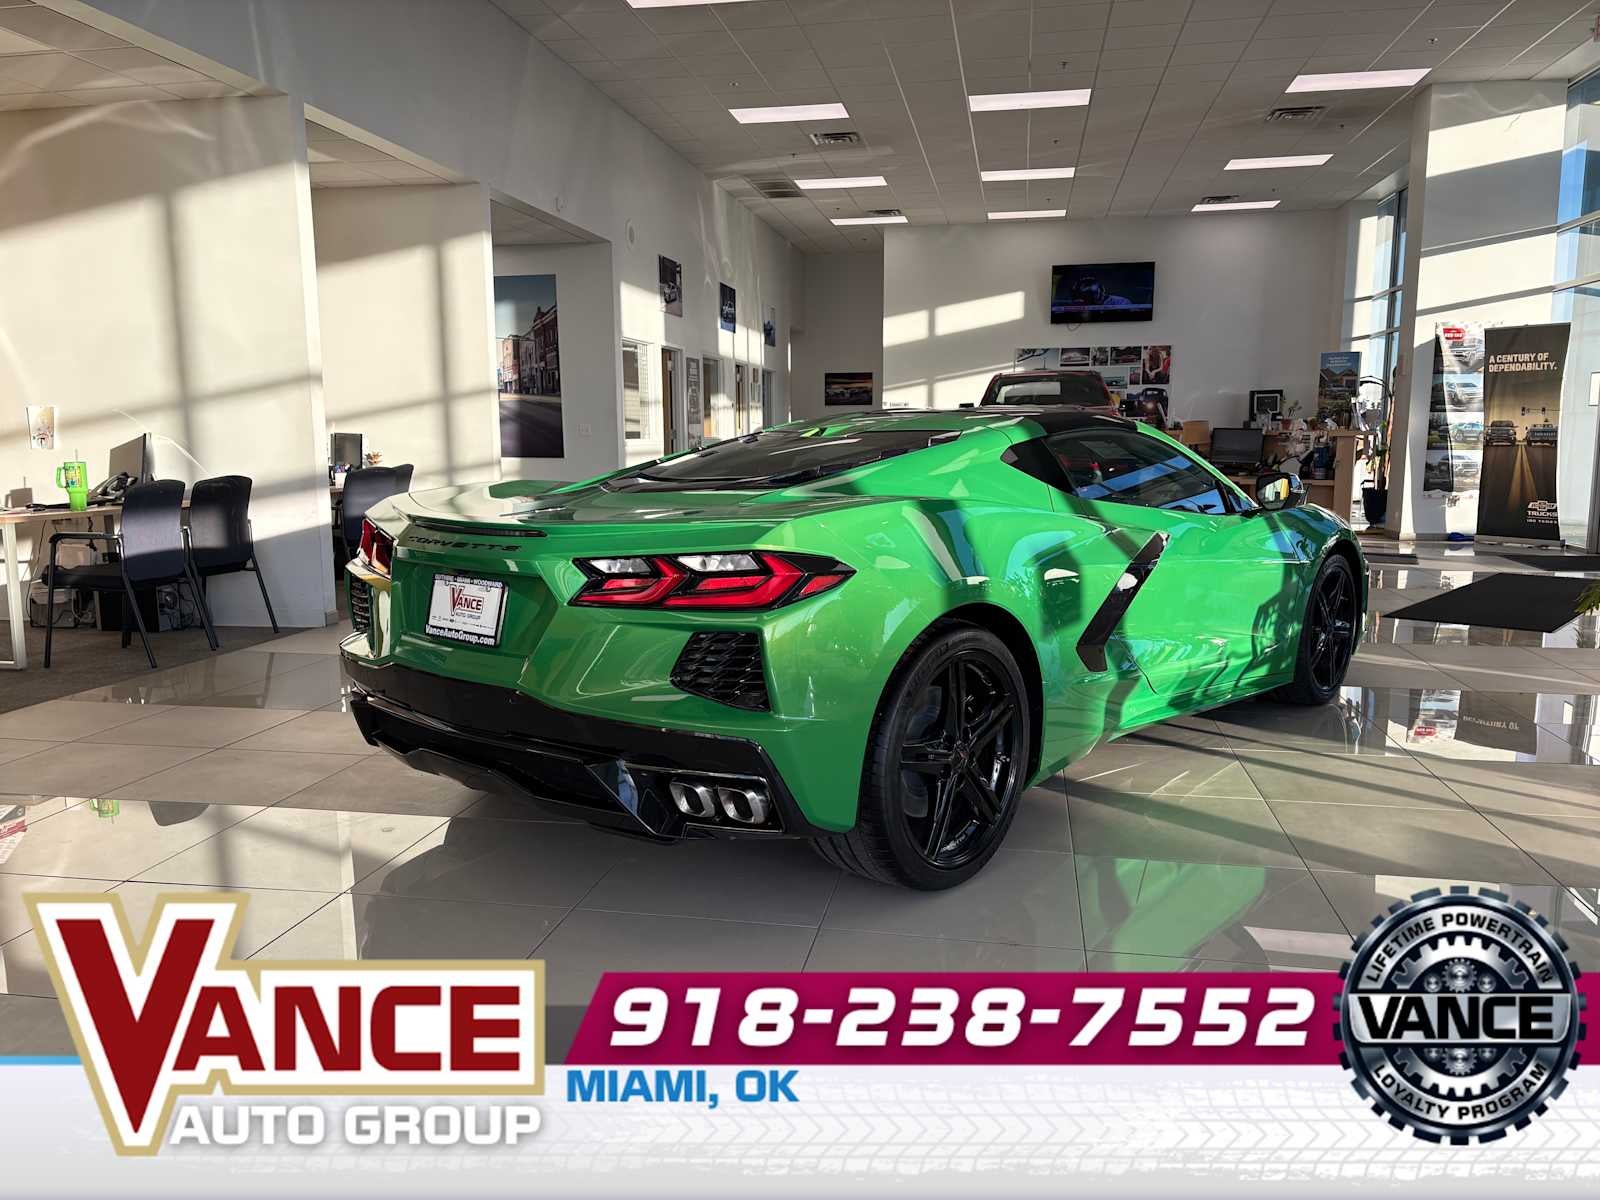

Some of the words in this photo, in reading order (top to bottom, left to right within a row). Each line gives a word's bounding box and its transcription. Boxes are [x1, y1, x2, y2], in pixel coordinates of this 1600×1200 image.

[1489, 355, 1495, 363] A
[1497, 353, 1536, 363] CENTURY
[1537, 352, 1549, 361] OF
[1489, 361, 1558, 373] DEPENDABILITY.
[408, 536, 521, 551] CORVETTE
[425, 624, 495, 646] VanceAutoGroup.com
